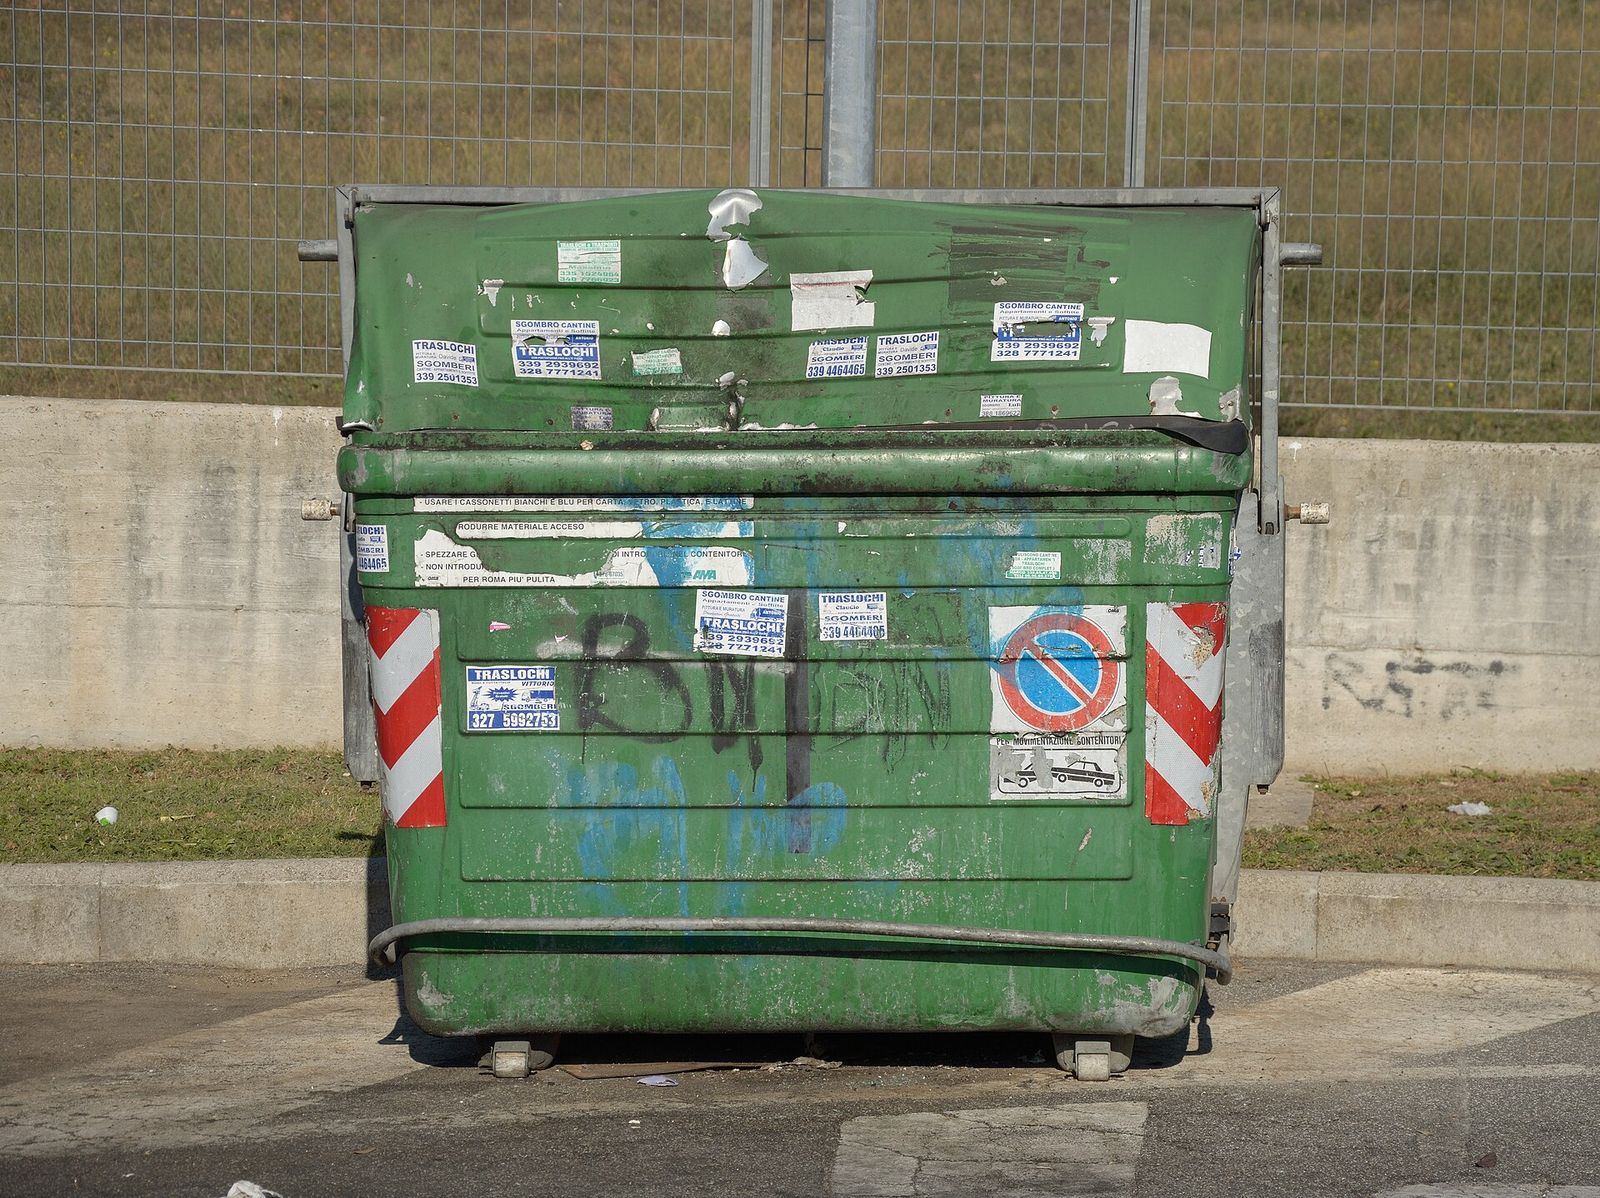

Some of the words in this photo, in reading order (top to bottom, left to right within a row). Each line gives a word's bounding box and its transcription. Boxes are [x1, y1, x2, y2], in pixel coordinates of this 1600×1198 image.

[515, 321, 560, 329] SGOMBRO
[878, 333, 938, 345] TRASLOCHI
[414, 342, 475, 355] TRASLOCHI
[519, 347, 594, 357] TRASLOCHI
[811, 354, 864, 362] SGOMBERI
[878, 352, 936, 362] SGOMBERI
[416, 360, 475, 371] SGOMBERI
[545, 361, 599, 369] 2939692
[808, 365, 825, 377] 339
[826, 363, 865, 376] 4464465
[876, 366, 894, 375] 339
[896, 363, 937, 374] 2501353
[416, 372, 434, 381] 339
[437, 373, 478, 385] 2501353
[546, 369, 599, 377] 7771241
[424, 498, 453, 506] USARE
[459, 498, 512, 506] CASSONETTI
[514, 498, 548, 506] BIANCHI
[558, 498, 574, 506] BLU
[576, 498, 593, 506] PER
[693, 569, 717, 580] AMA
[701, 590, 747, 600] SGOMBRO
[748, 595, 785, 603] CANTINE
[821, 594, 884, 603] TRASLOCHI
[824, 614, 883, 622] SGOMBERI
[703, 617, 781, 633] TRASLOCHI
[727, 634, 784, 646] 2939692
[727, 643, 783, 654] 7771241
[474, 669, 550, 680] TRASLOCHI
[472, 713, 495, 728] 327
[502, 712, 556, 728] 5992753
[1013, 736, 1074, 746] MOVIMENTAZIONE
